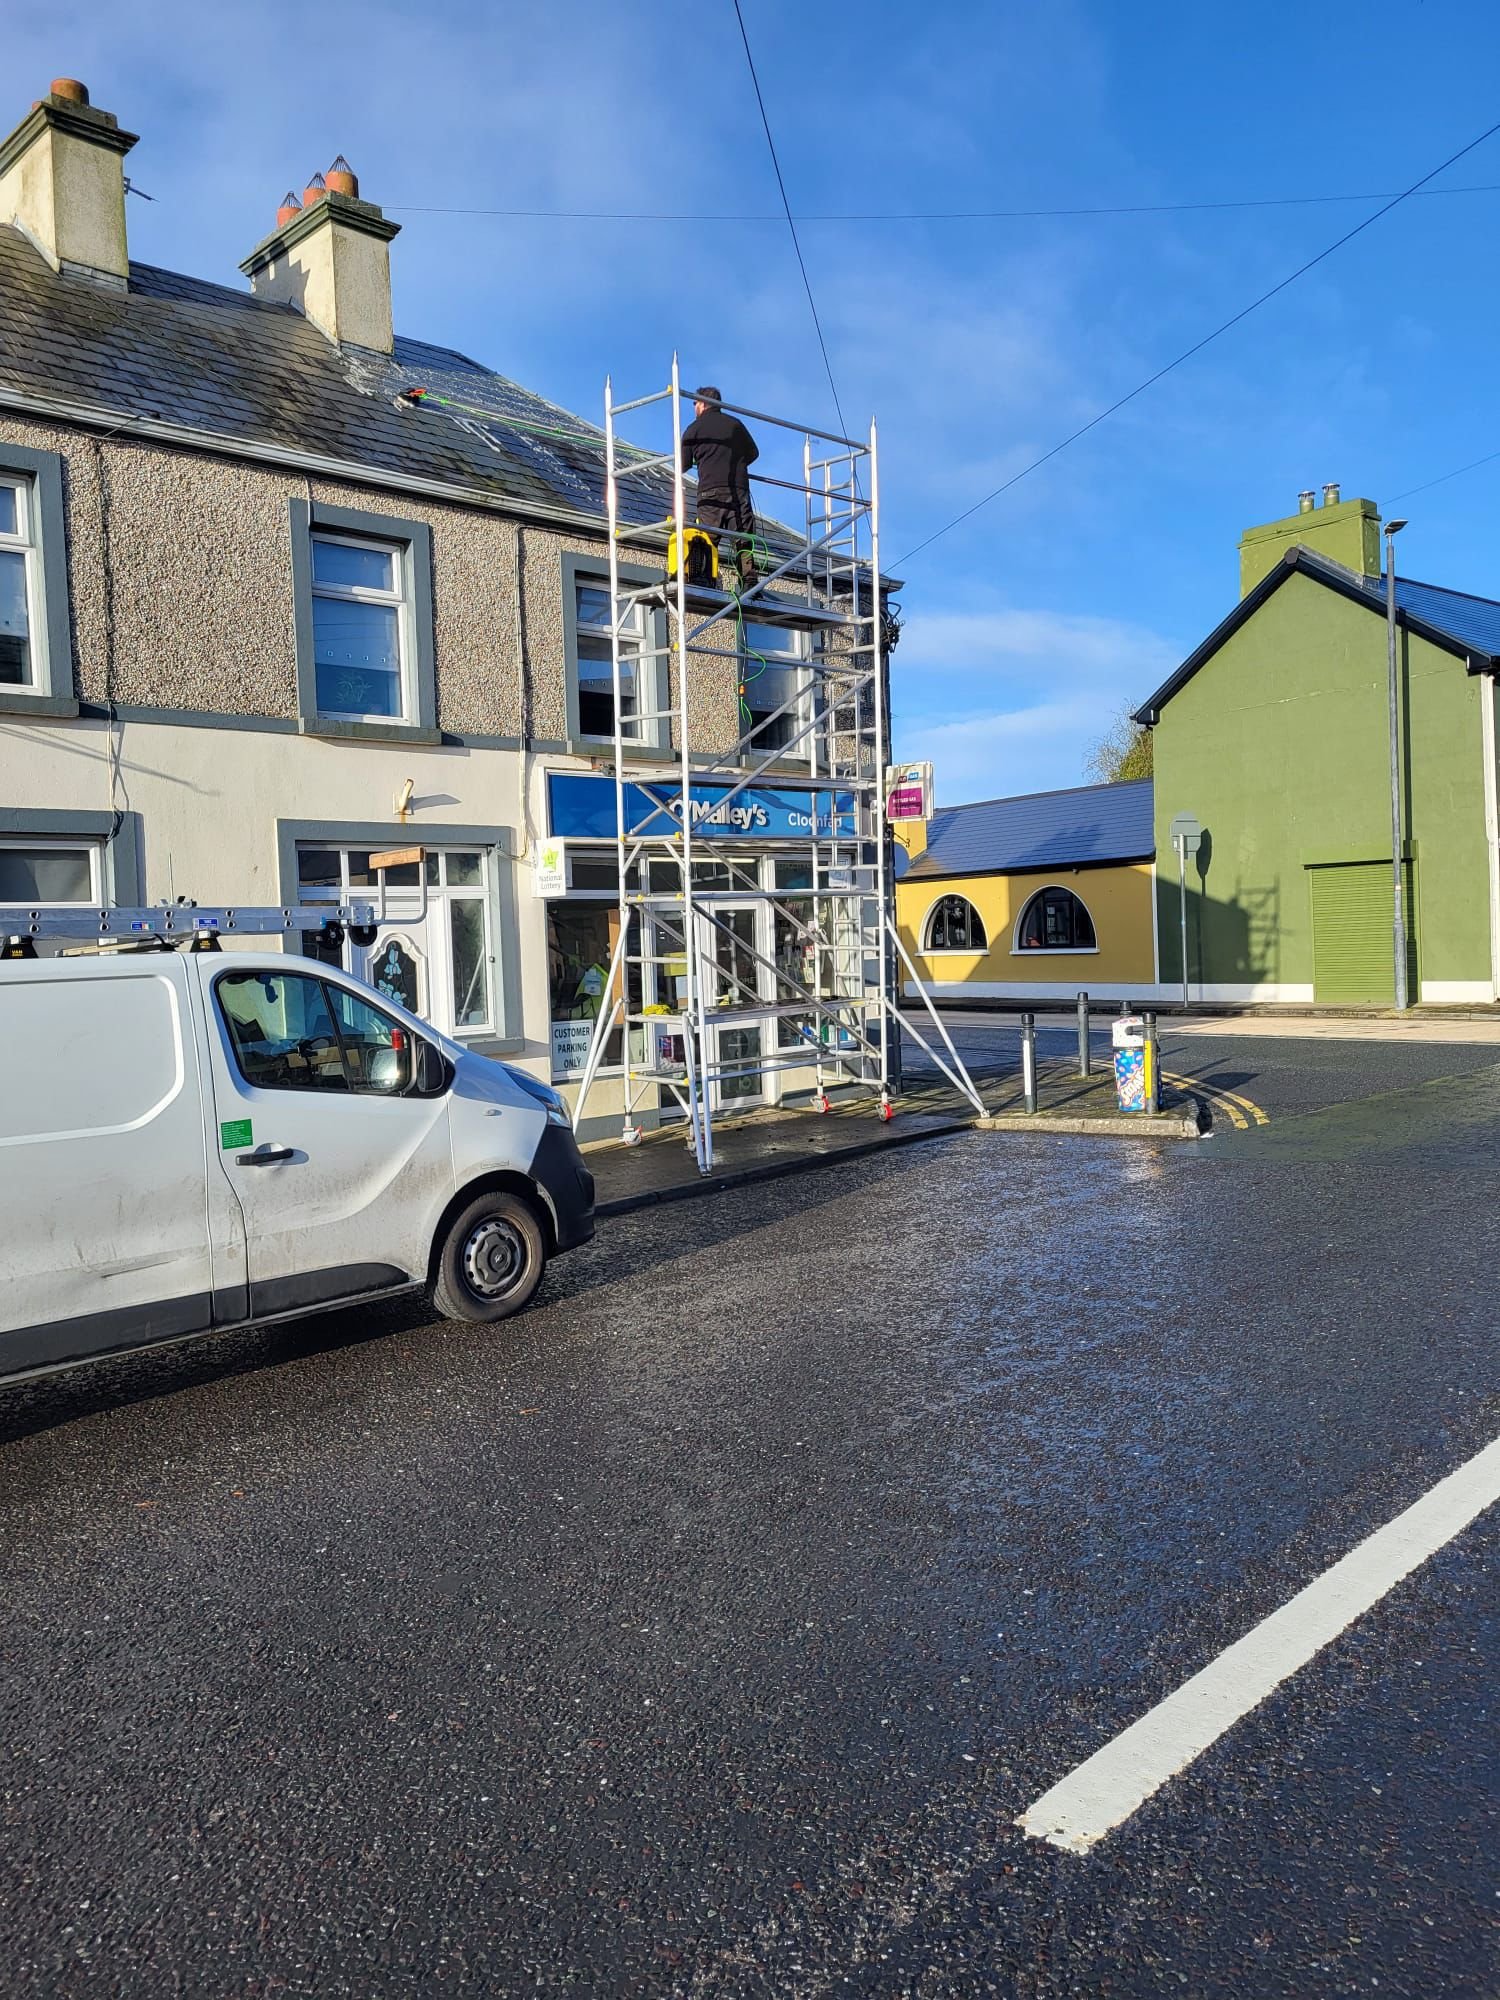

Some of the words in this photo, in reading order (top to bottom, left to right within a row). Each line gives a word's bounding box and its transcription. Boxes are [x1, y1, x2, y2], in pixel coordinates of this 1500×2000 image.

[669, 799, 767, 830] O'Malley's
[538, 873, 563, 881] National
[540, 879, 561, 889] Lottery
[554, 1026, 590, 1039] CUSTOMER
[557, 1042, 587, 1054] PARKING
[563, 1056, 581, 1068] ONLY
